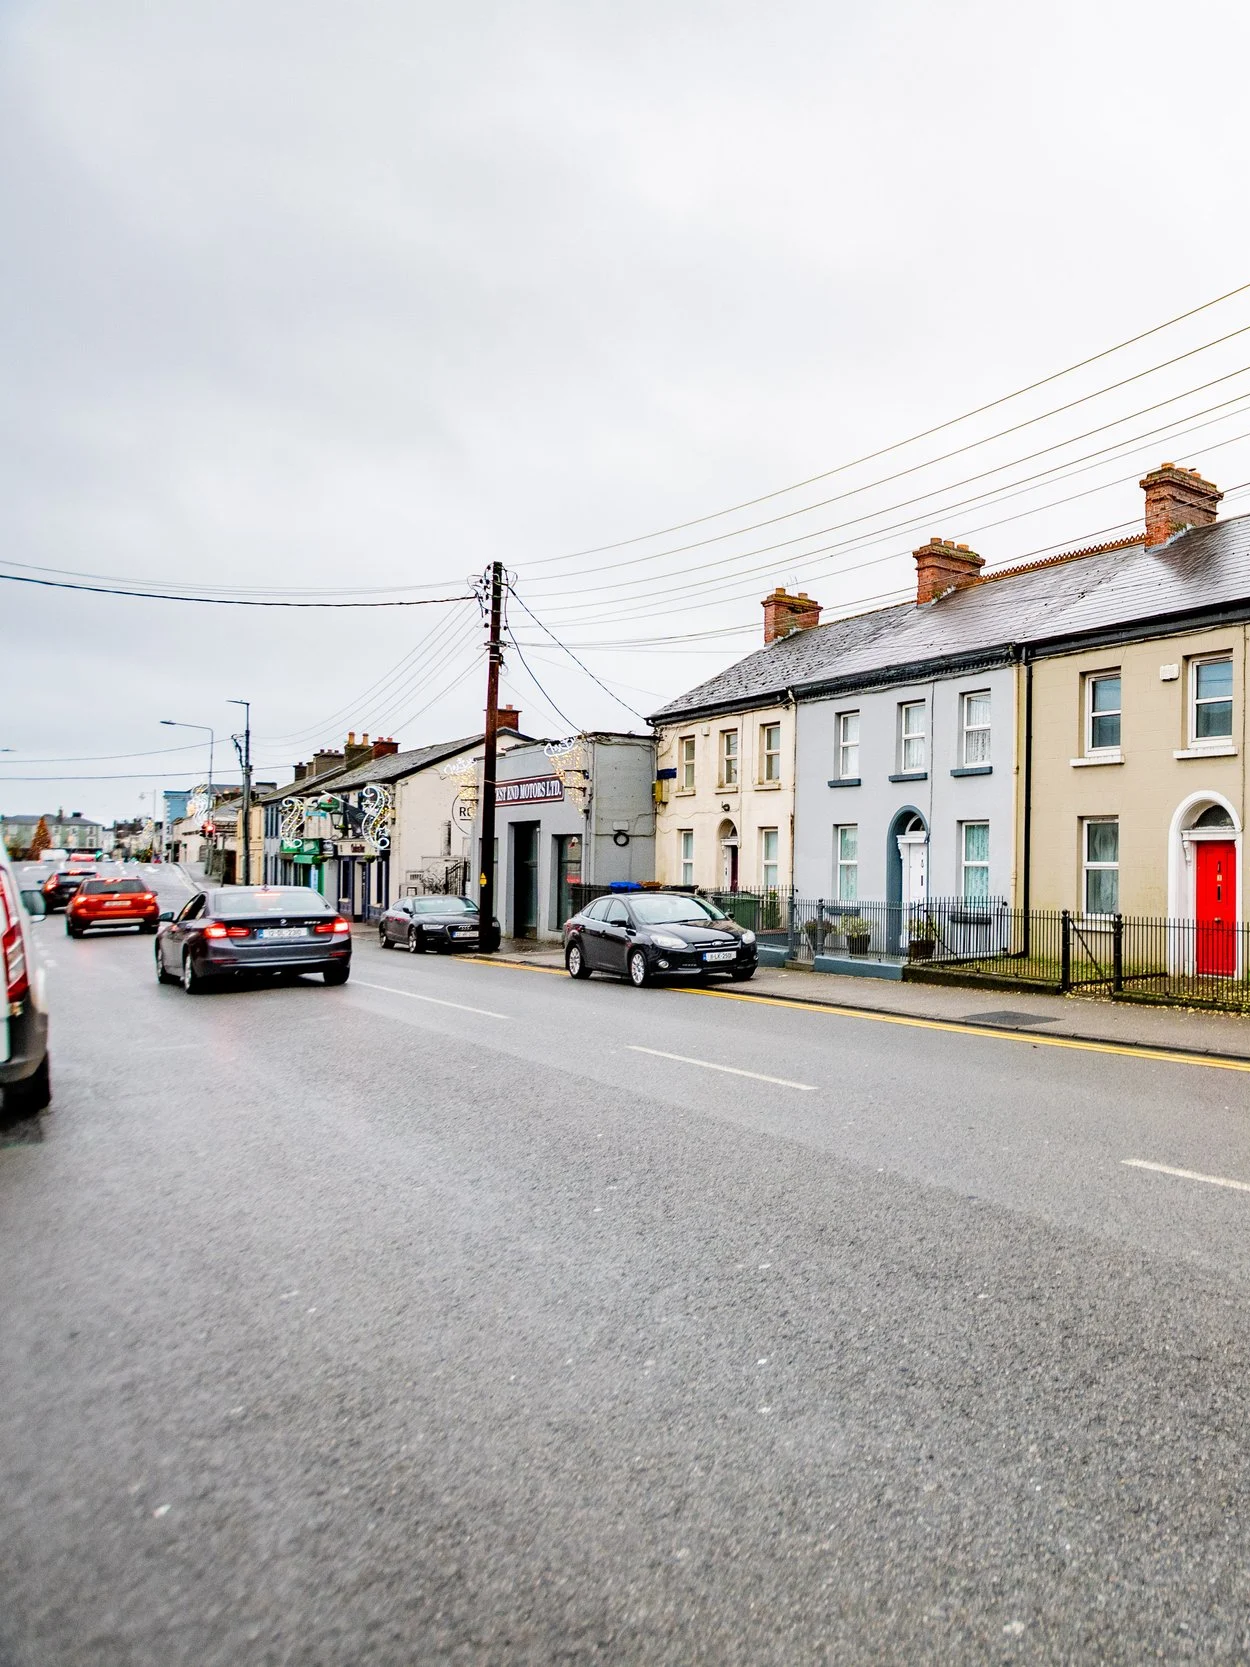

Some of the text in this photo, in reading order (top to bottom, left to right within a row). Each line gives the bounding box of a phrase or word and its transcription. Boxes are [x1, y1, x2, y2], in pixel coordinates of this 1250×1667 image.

[495, 780, 562, 802] EST END MOTORS LTD.
